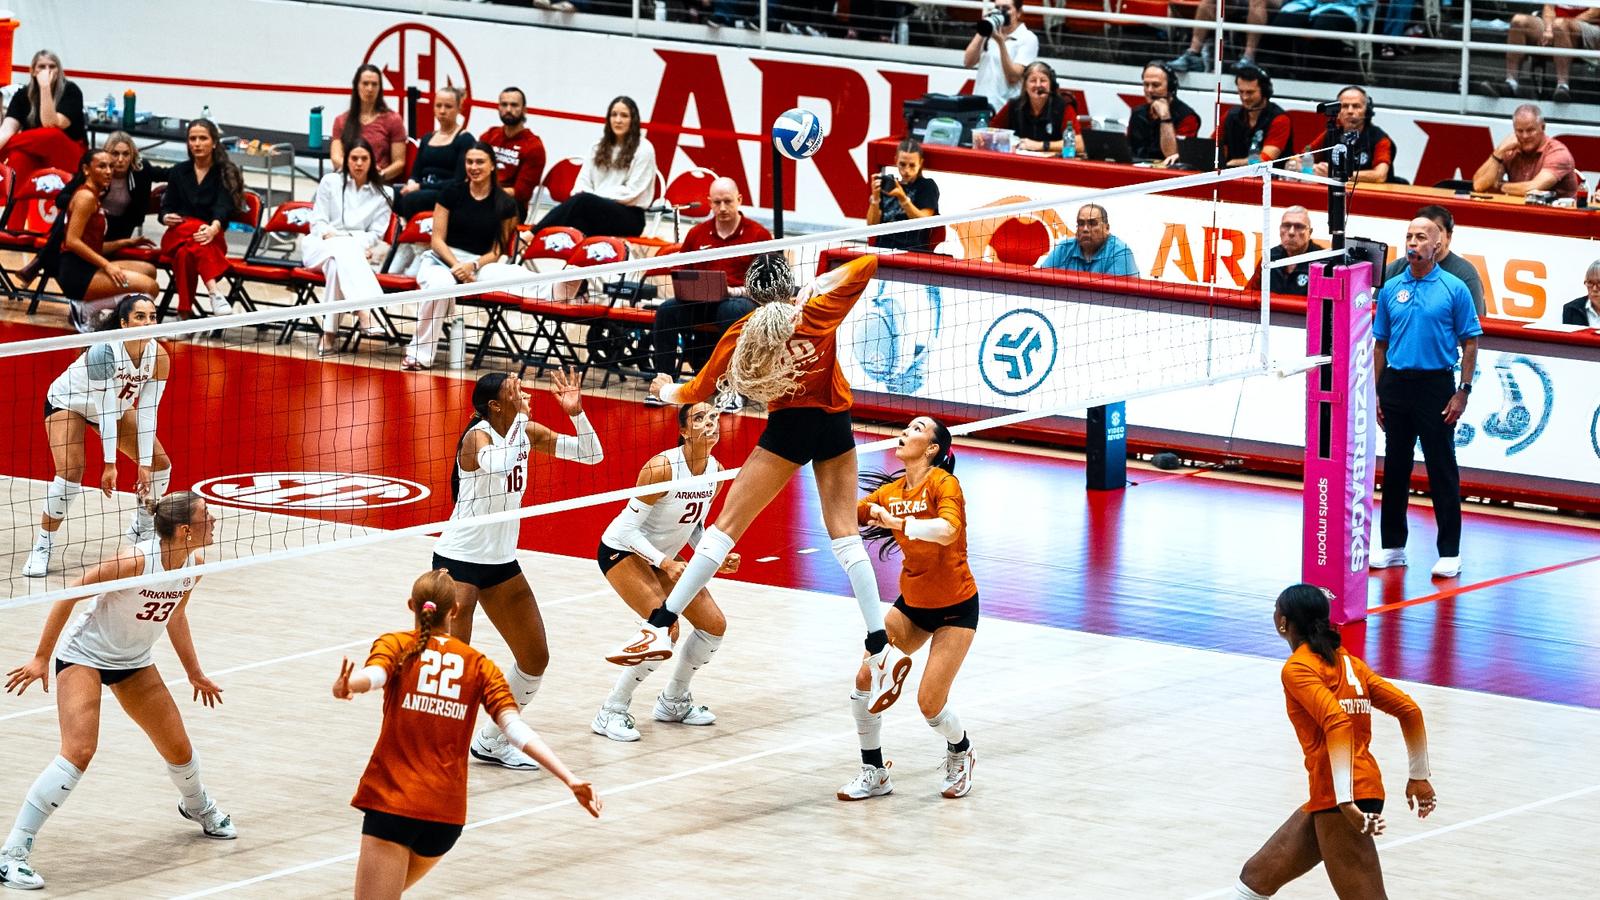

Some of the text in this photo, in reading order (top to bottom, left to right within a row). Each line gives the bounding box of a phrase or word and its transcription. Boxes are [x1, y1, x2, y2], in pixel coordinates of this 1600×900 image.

[1107, 426, 1125, 434] VIDEO
[1107, 433, 1125, 441] REVIEW
[1350, 340, 1368, 573] RAZORBACKS
[507, 465, 523, 492] 16
[675, 490, 713, 500] ARKANSAS
[889, 499, 928, 516] TEXAS
[679, 501, 704, 524] 21
[1318, 477, 1328, 566] sports imports
[136, 602, 176, 622] 33
[417, 648, 464, 699] 22
[1343, 655, 1364, 695] 4
[401, 692, 469, 721] ANDERSON
